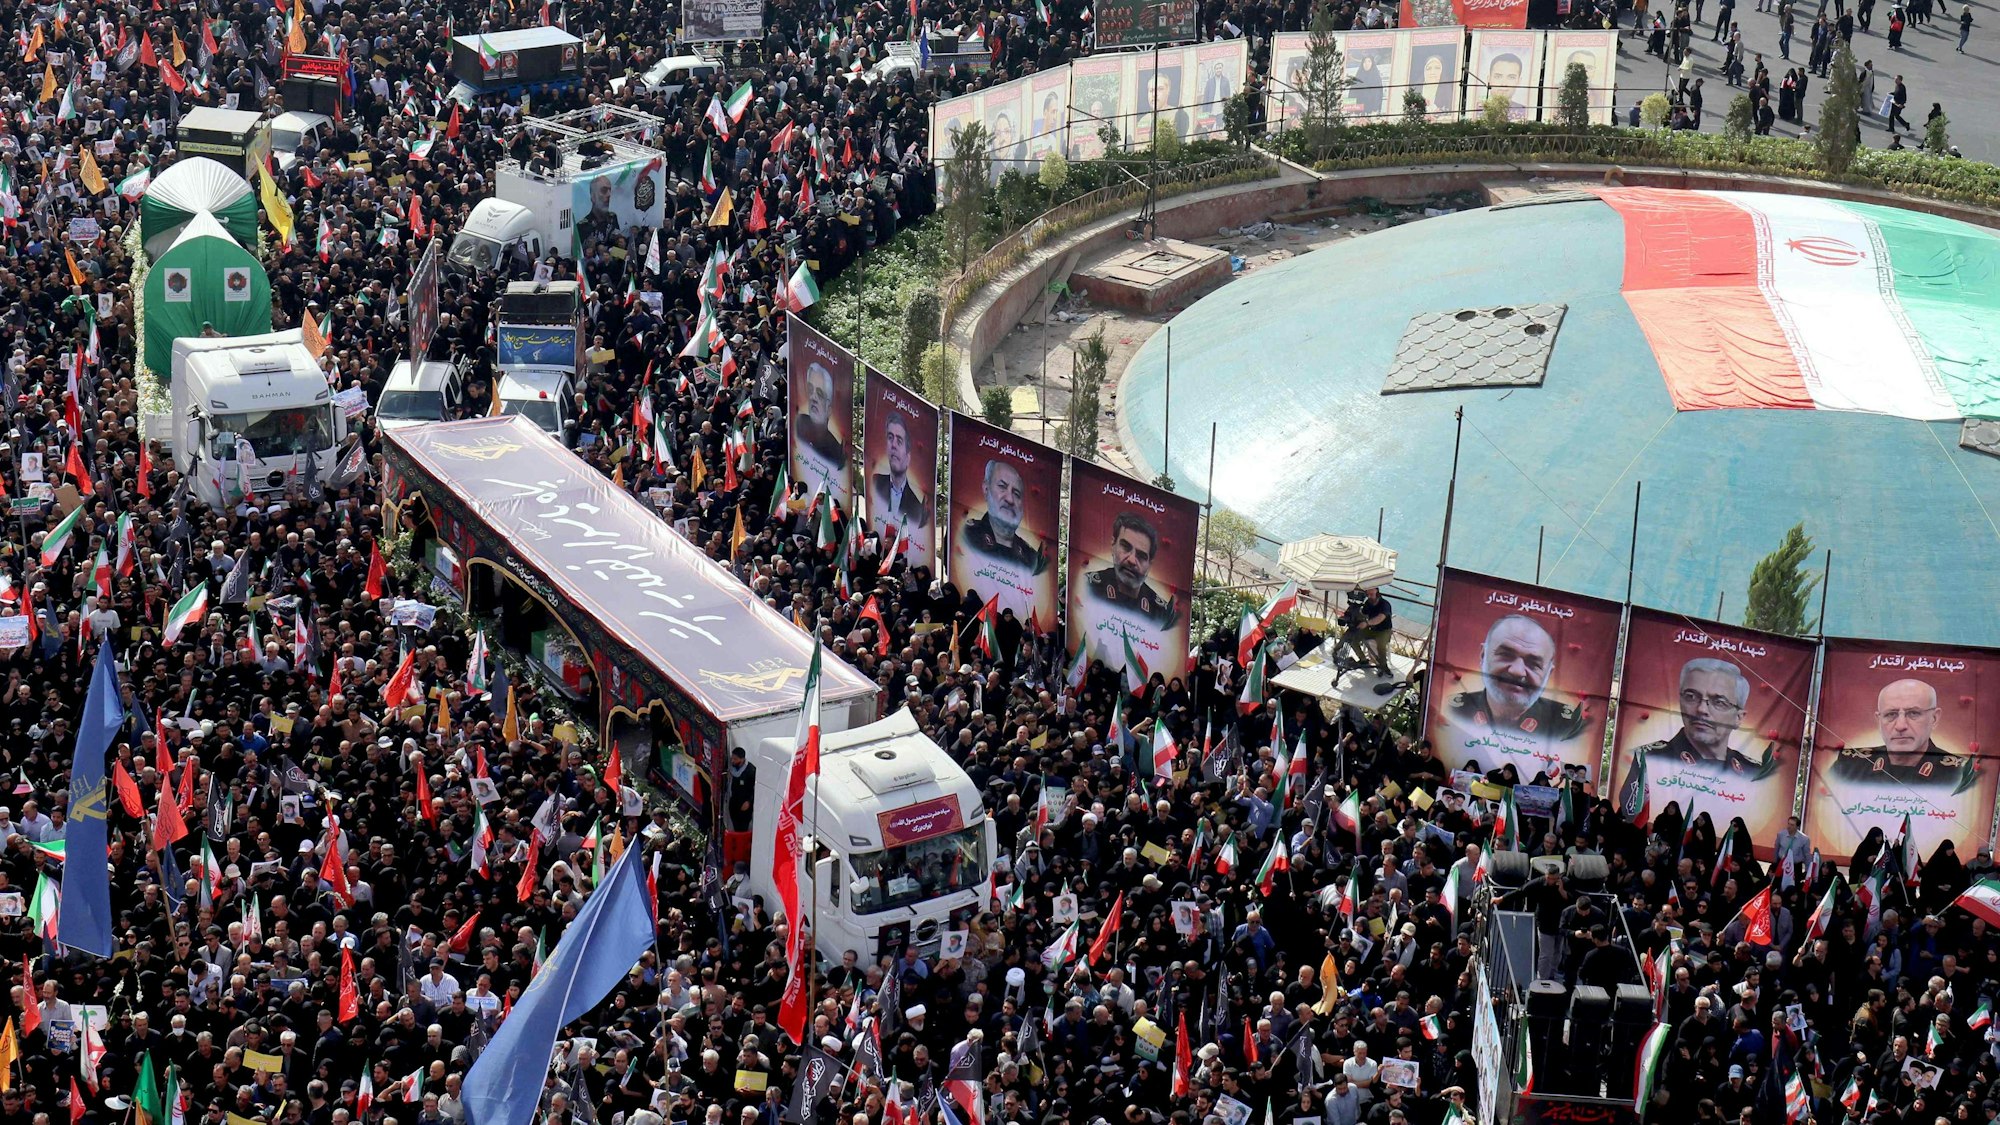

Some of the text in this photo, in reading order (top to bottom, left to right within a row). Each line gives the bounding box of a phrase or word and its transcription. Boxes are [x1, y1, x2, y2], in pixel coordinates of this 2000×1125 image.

[252, 391, 291, 399] BAHMAN
[979, 435, 1034, 463] شهدا مظهر اقتدار
[1102, 483, 1165, 514] شهدا مظهر اقتدار
[996, 576, 1016, 589] محمد
[1016, 583, 1034, 596] شهید
[1485, 591, 1574, 618] شهدا مظهر اقتدار
[1141, 638, 1160, 650] شهید
[1674, 630, 1766, 657] شهدا مظهر اقتدار
[1869, 654, 1965, 672] شهدا مظهر اقتدار
[1464, 736, 1500, 748] سلامی
[1500, 744, 1532, 755] حسین
[1656, 775, 1746, 802] شهید محمد باقری
[1841, 802, 1881, 815] محرابی
[1928, 809, 1956, 820] شهید
